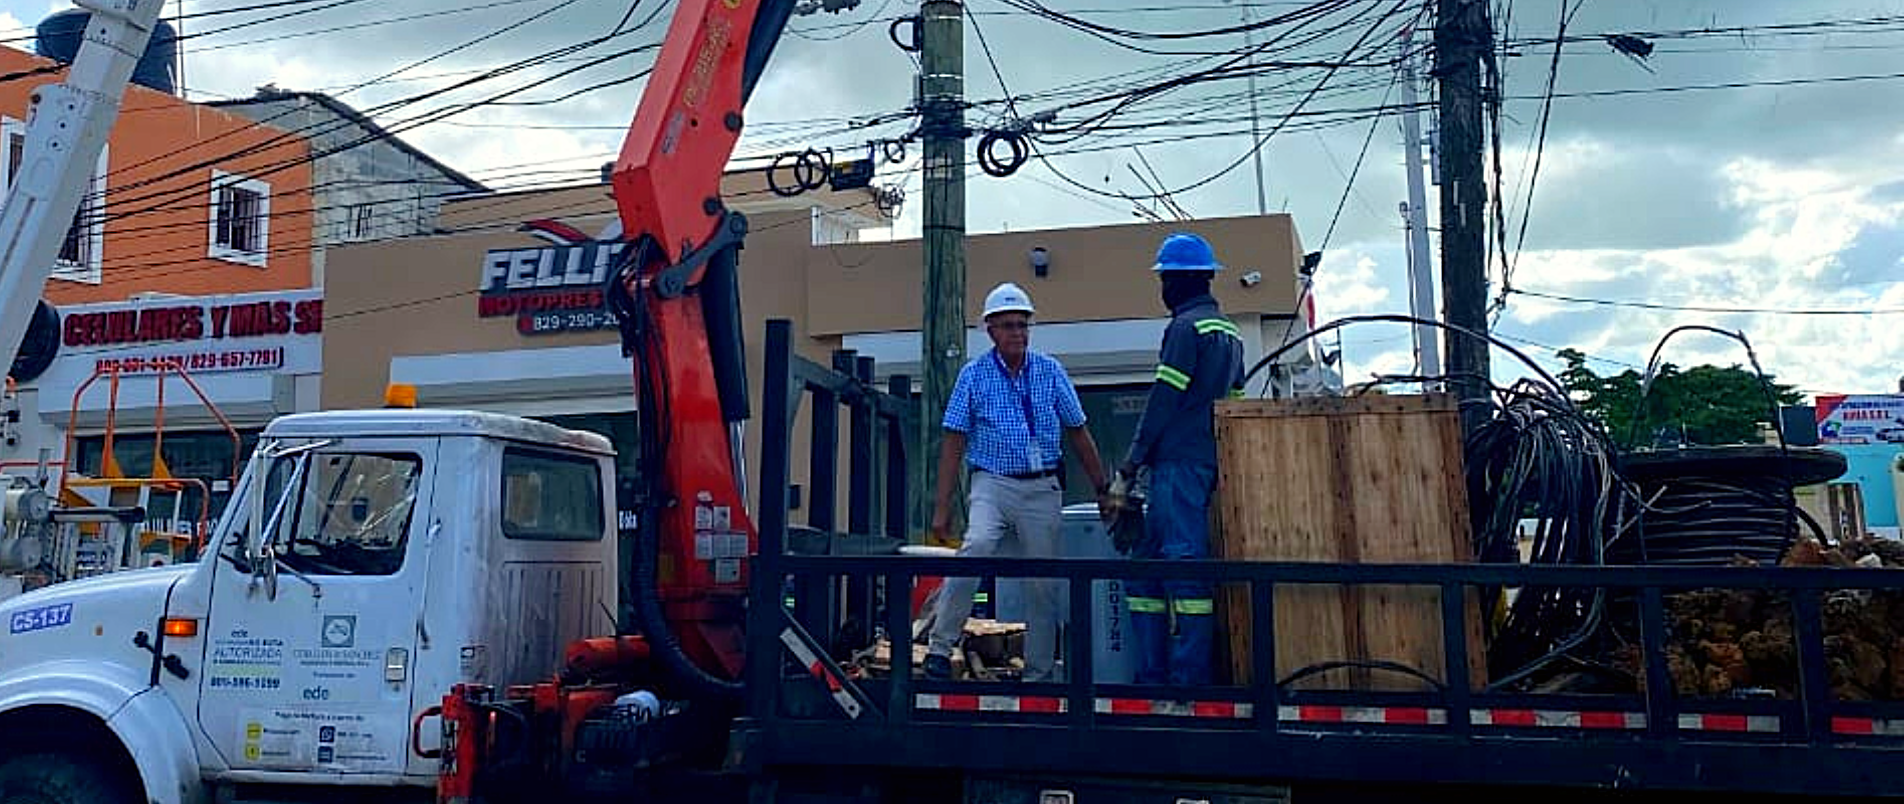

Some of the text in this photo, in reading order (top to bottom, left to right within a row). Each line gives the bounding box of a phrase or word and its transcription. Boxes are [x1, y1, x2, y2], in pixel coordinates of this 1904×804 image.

[480, 243, 626, 288] FELLI
[63, 305, 204, 346] CELULARES
[211, 305, 230, 339] Y
[13, 604, 72, 631] CS-137
